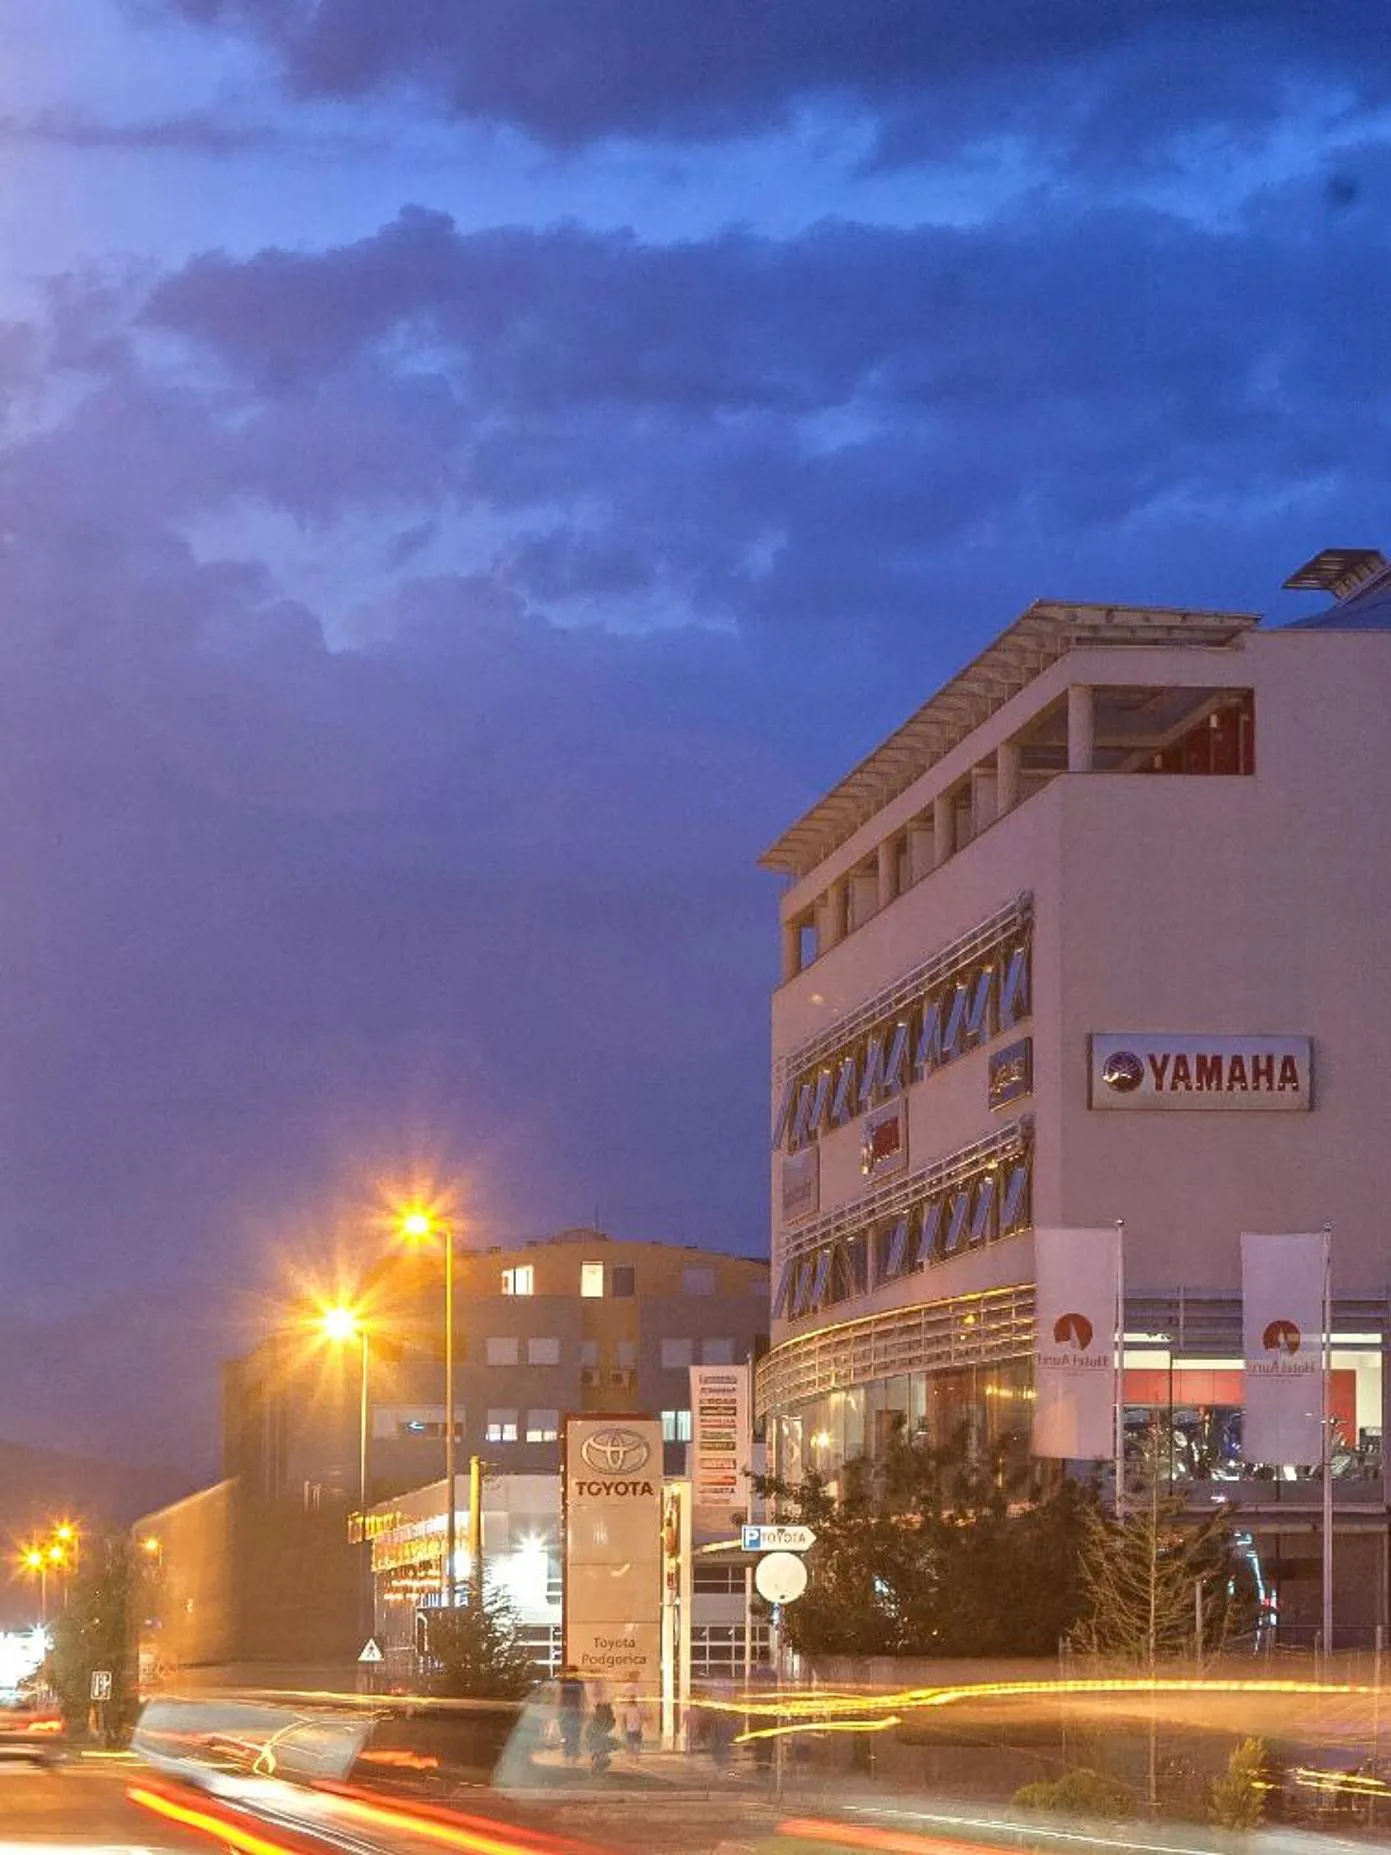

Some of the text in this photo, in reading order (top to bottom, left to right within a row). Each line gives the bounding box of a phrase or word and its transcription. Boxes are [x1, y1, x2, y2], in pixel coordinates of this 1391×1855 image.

[1148, 1053, 1300, 1092] YAMAHA
[575, 1481, 654, 1497] TOYOTA
[762, 1531, 806, 1544] TOYOTA
[593, 1637, 636, 1650] Toyota
[581, 1653, 648, 1668] Podgorica
